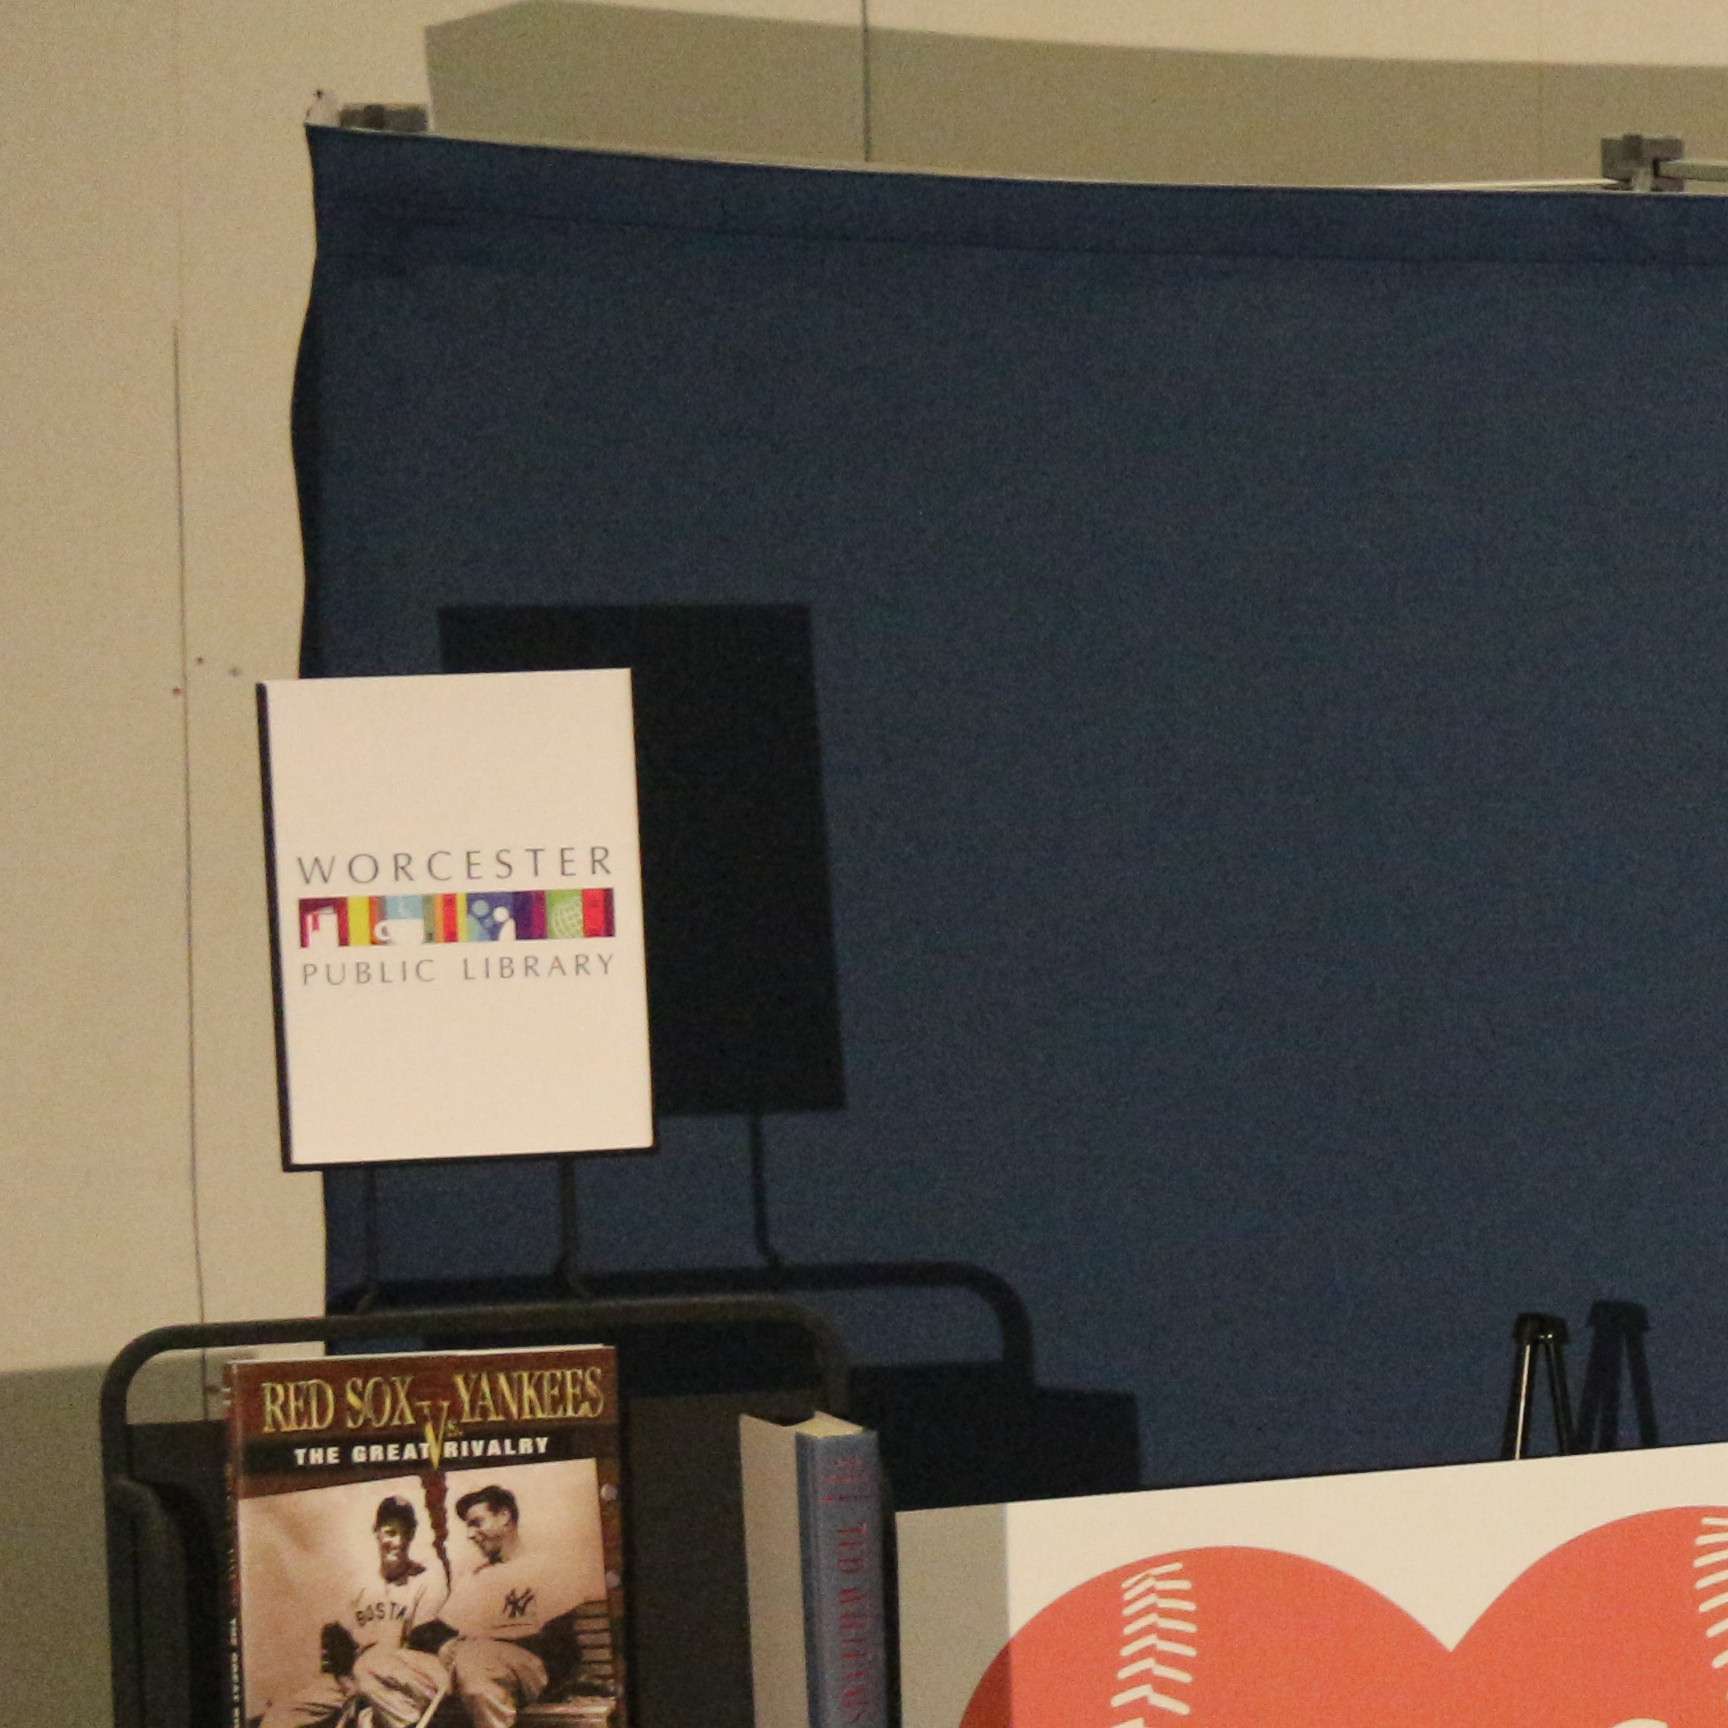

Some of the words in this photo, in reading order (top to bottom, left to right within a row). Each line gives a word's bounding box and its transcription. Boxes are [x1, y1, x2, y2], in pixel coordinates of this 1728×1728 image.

[297, 844, 612, 885] WORCESTER
[302, 959, 436, 987] PUBLIC
[462, 953, 615, 982] LIBRARY
[262, 1379, 335, 1433] RED
[346, 1376, 416, 1429] SOX
[454, 1367, 604, 1423] YANKEES
[295, 1447, 339, 1466] THE
[352, 1443, 430, 1463] GREAT
[443, 1436, 549, 1458] RIVALRY
